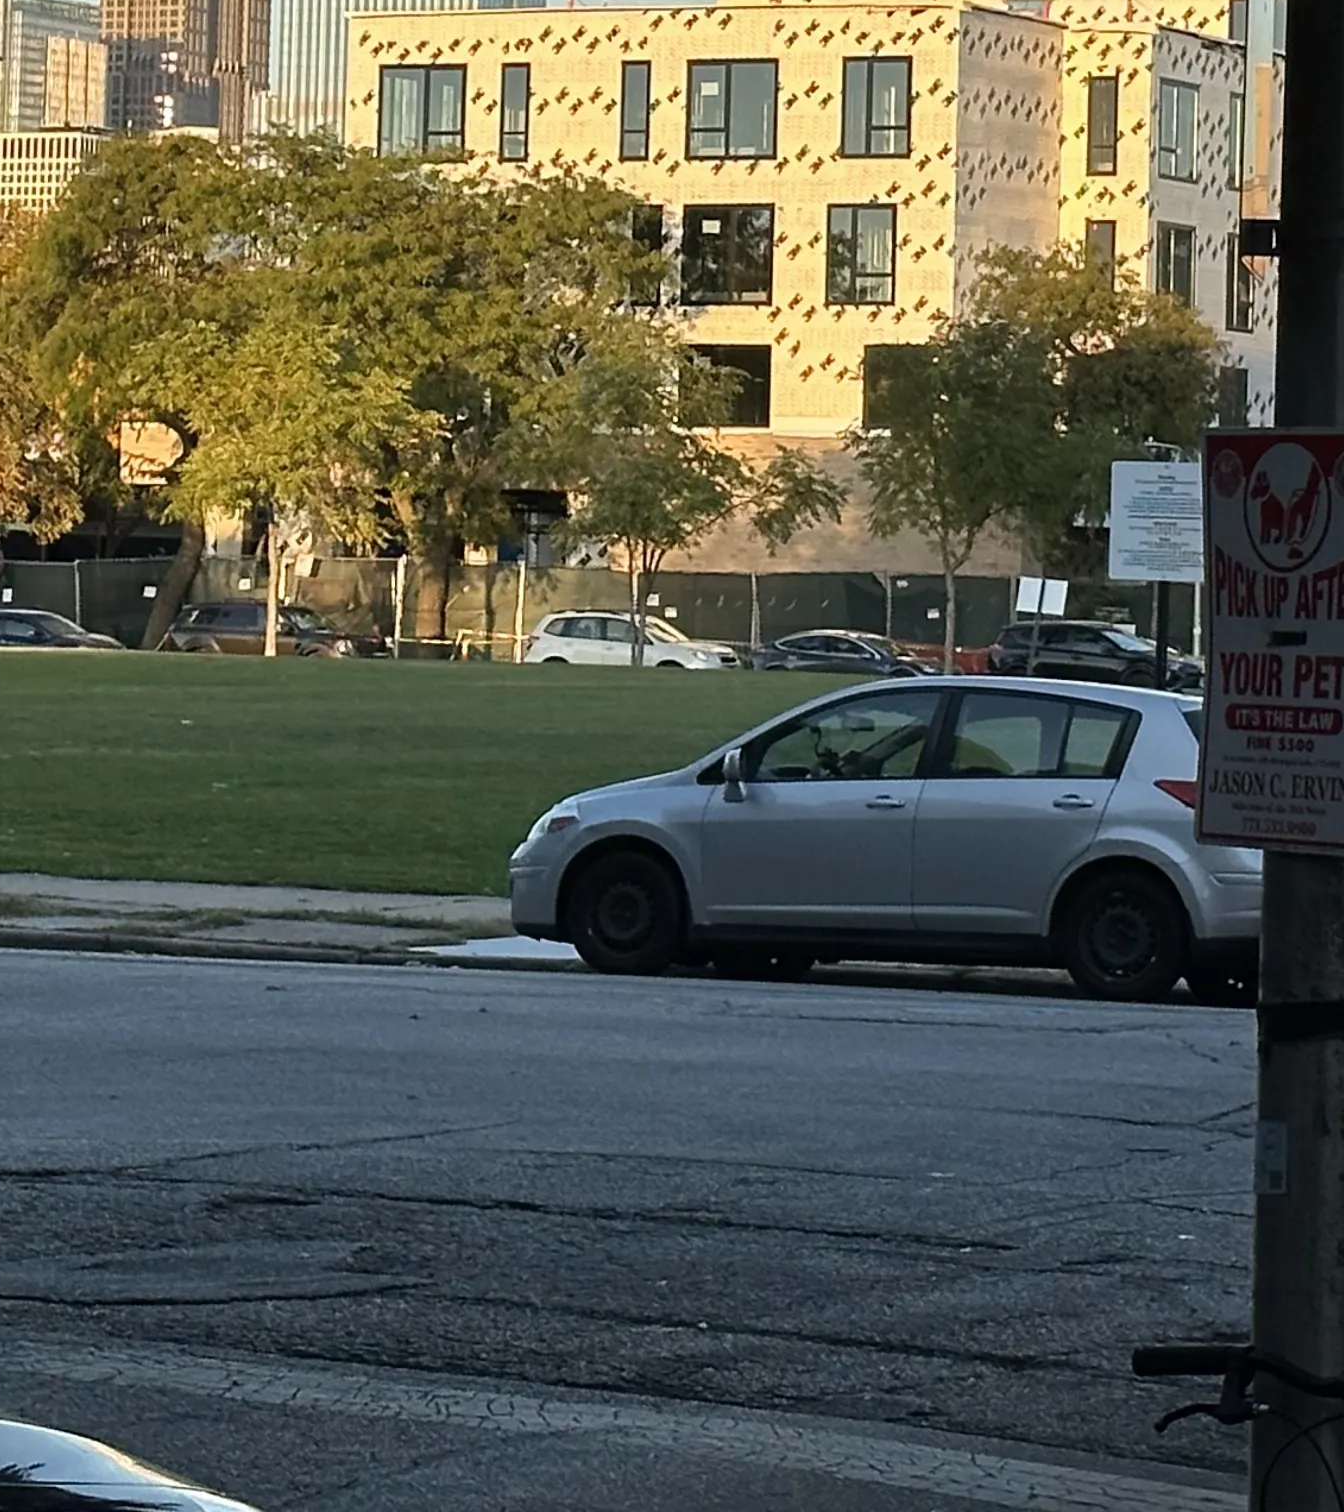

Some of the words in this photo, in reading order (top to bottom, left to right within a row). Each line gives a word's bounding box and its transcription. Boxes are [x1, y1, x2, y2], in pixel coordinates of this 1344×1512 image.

[1214, 544, 1259, 618] PICK
[1264, 576, 1290, 618] UP
[1220, 652, 1283, 698] YOUR
[1234, 708, 1261, 728] IT'S
[1264, 709, 1294, 729] THE
[1298, 712, 1335, 731] LAW
[1277, 737, 1315, 753] $500
[1208, 769, 1265, 797] JASON
[1269, 773, 1286, 799] C.
